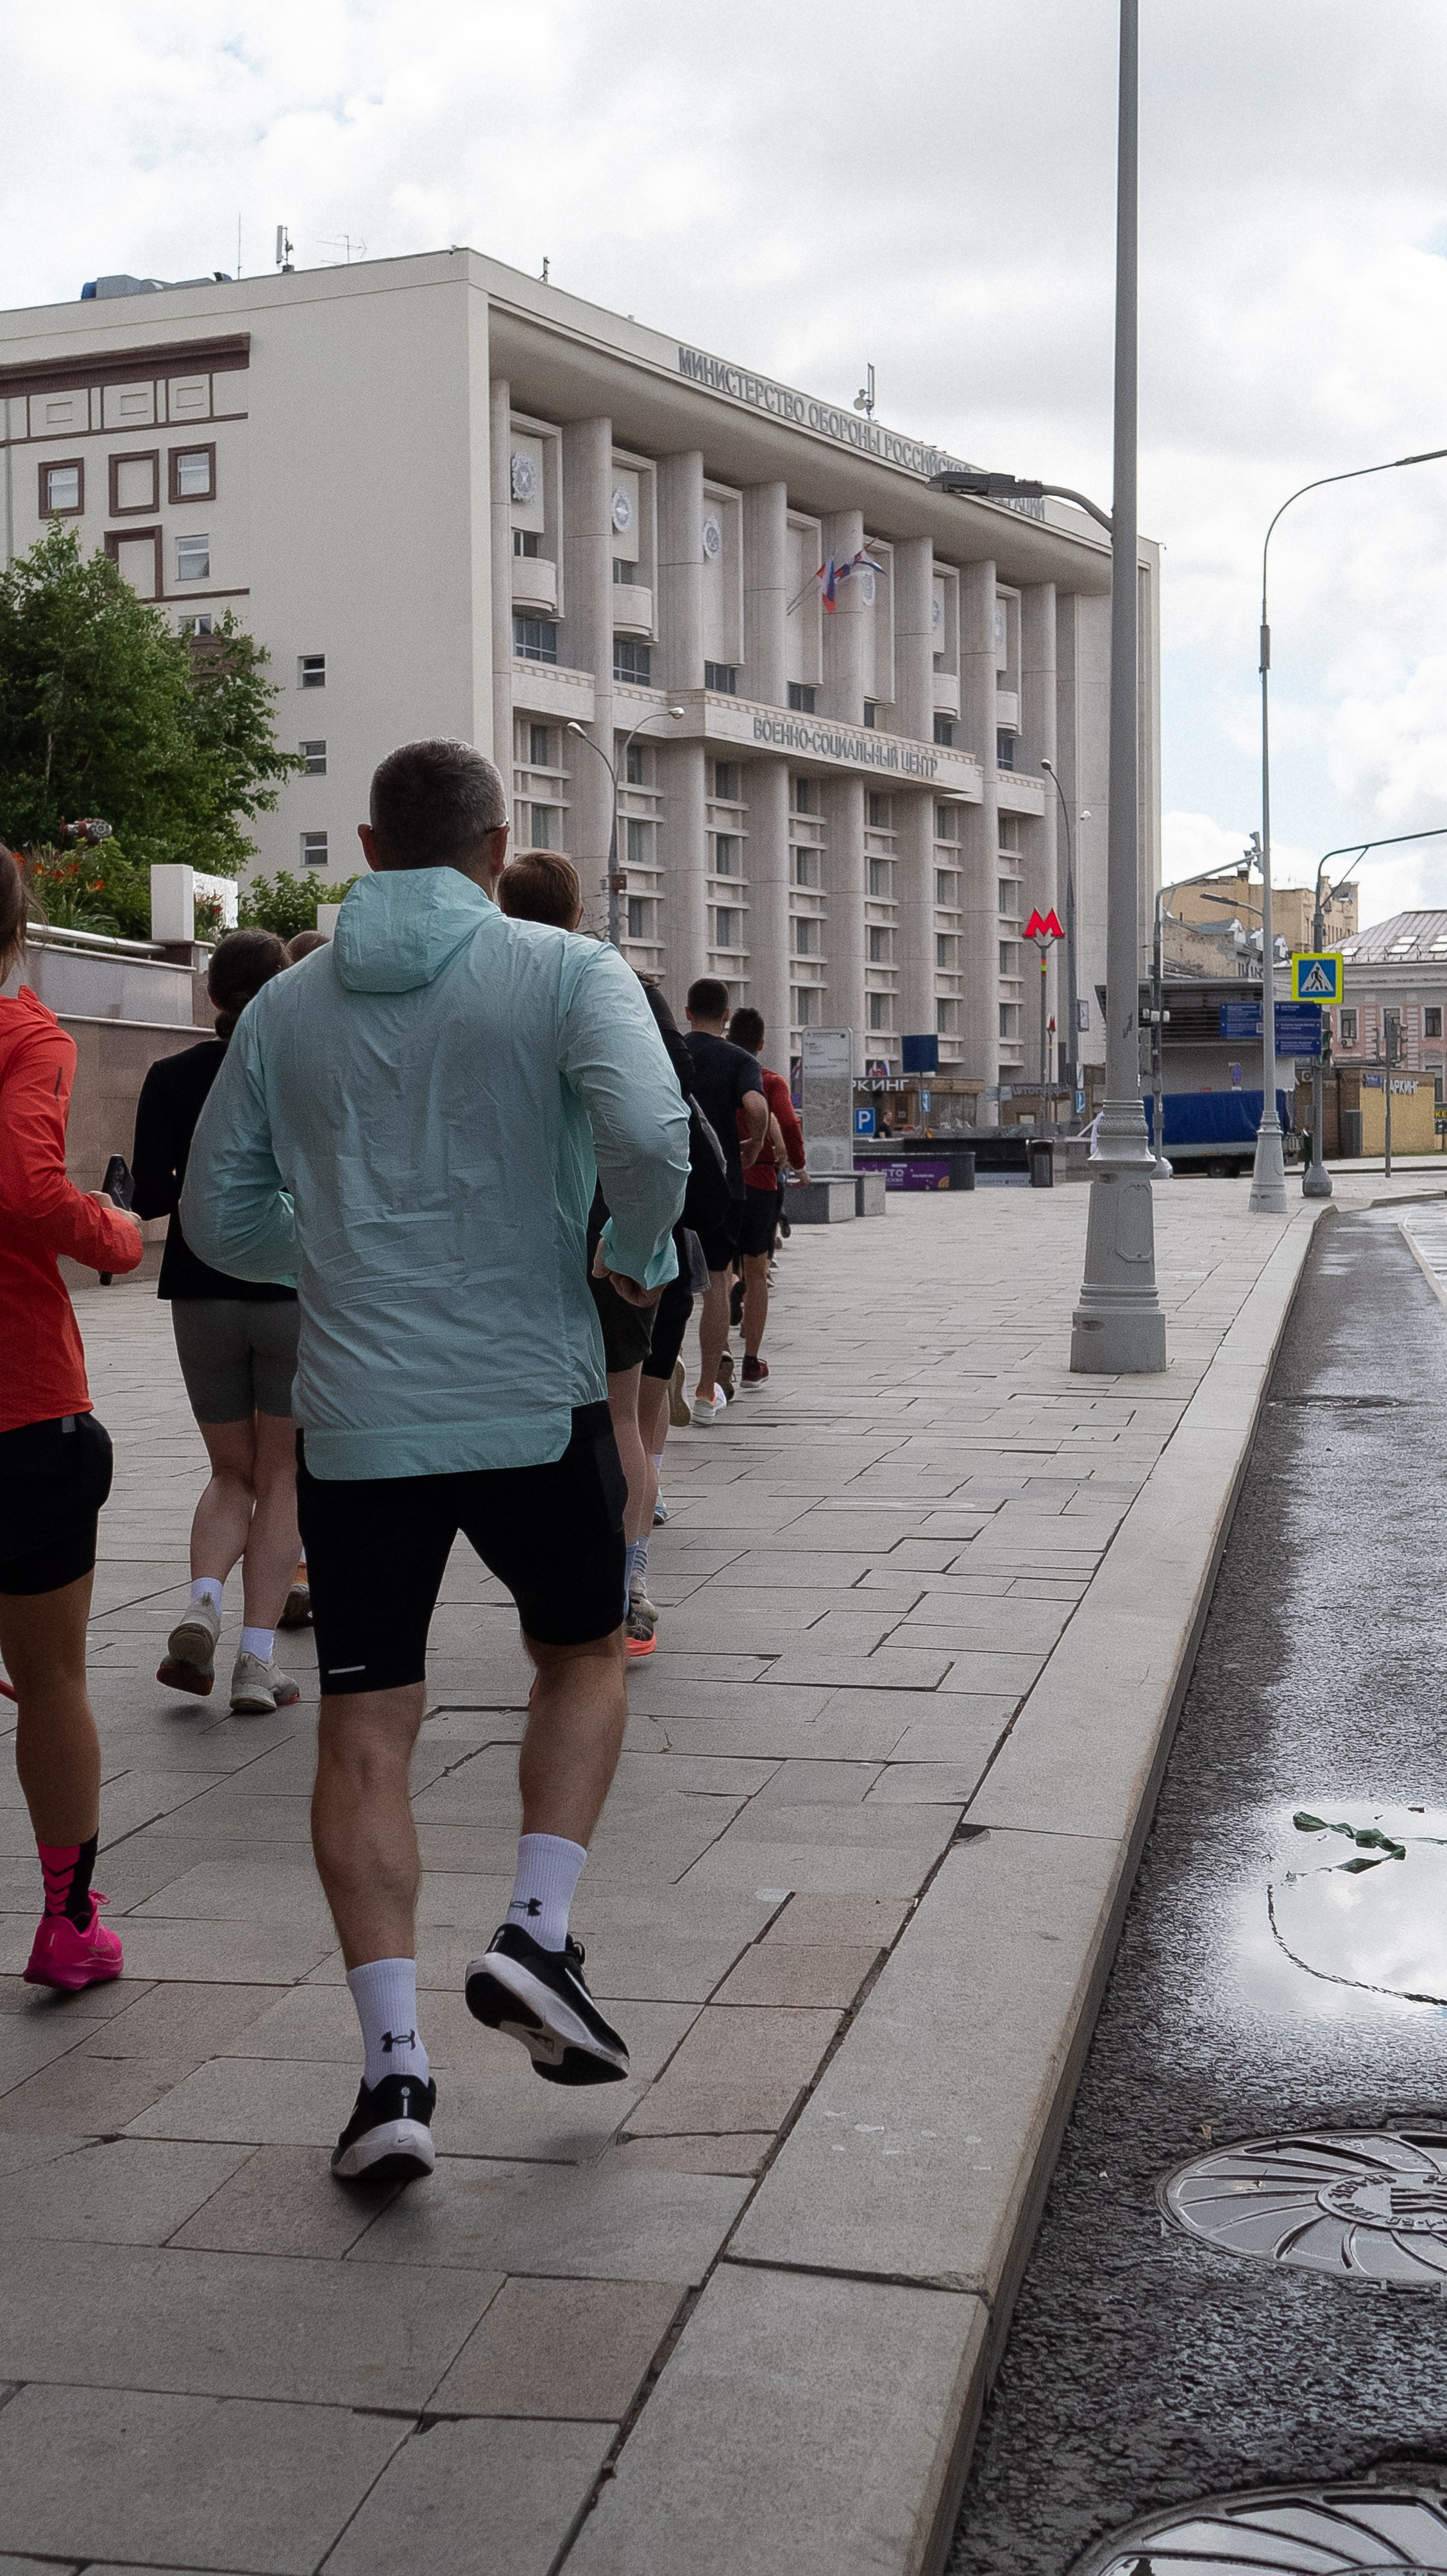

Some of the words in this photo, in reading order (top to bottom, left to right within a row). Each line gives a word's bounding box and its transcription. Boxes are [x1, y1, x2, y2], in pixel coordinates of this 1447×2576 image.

[679, 347, 805, 423] МИНИСТЕРСТВО
[809, 403, 880, 454] ОБОРОНЫ
[884, 434, 972, 475] РОССИЙСК
[753, 716, 899, 770] ВОЕННО-СОЦИАЛЬНЫЙ
[901, 750, 938, 777] ЦЕНТР
